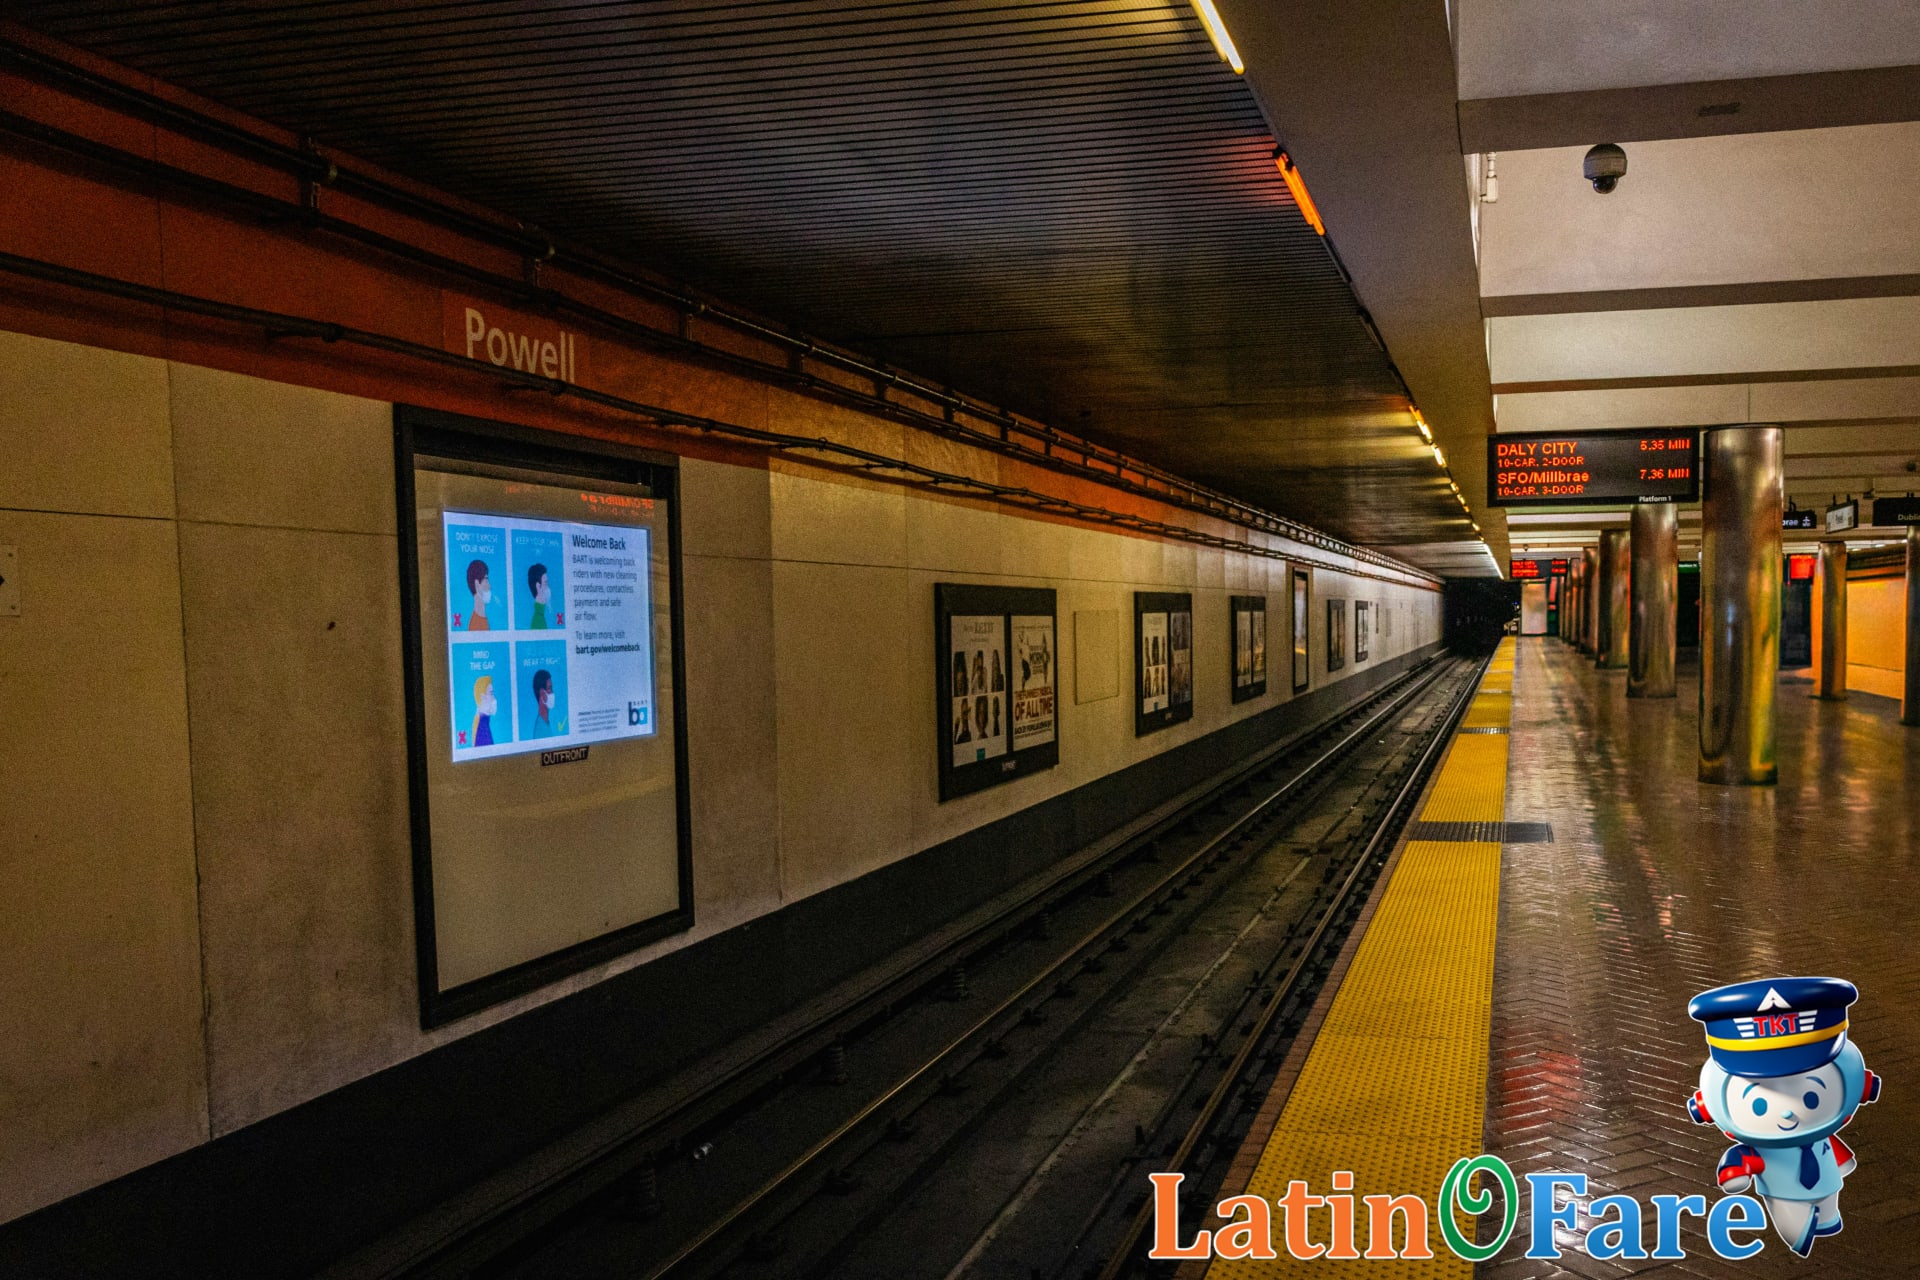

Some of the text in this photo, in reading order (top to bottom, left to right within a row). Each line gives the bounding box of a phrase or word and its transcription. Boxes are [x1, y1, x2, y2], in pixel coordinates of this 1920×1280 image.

[465, 307, 575, 384] Powell
[1497, 441, 1578, 456] DALY CITY
[1668, 438, 1690, 450] MIN
[1542, 455, 1585, 466] 2-DOOR
[1497, 470, 1590, 485] SFO/Millbrae
[1667, 467, 1690, 479] MIN
[1542, 484, 1585, 495] 3-DOOR
[572, 534, 626, 550] Welcome Back
[572, 554, 588, 564] BART
[594, 556, 622, 569] welcoming
[573, 570, 638, 582] riders with new cleaning
[575, 598, 598, 608] payment
[599, 597, 609, 607] and
[576, 631, 582, 640] To
[584, 631, 597, 640] learn
[576, 642, 640, 656] bart.gov/welcomeback
[1015, 702, 1025, 721] OF
[1026, 699, 1040, 719] ALL
[543, 747, 588, 764] OUTFRONT
